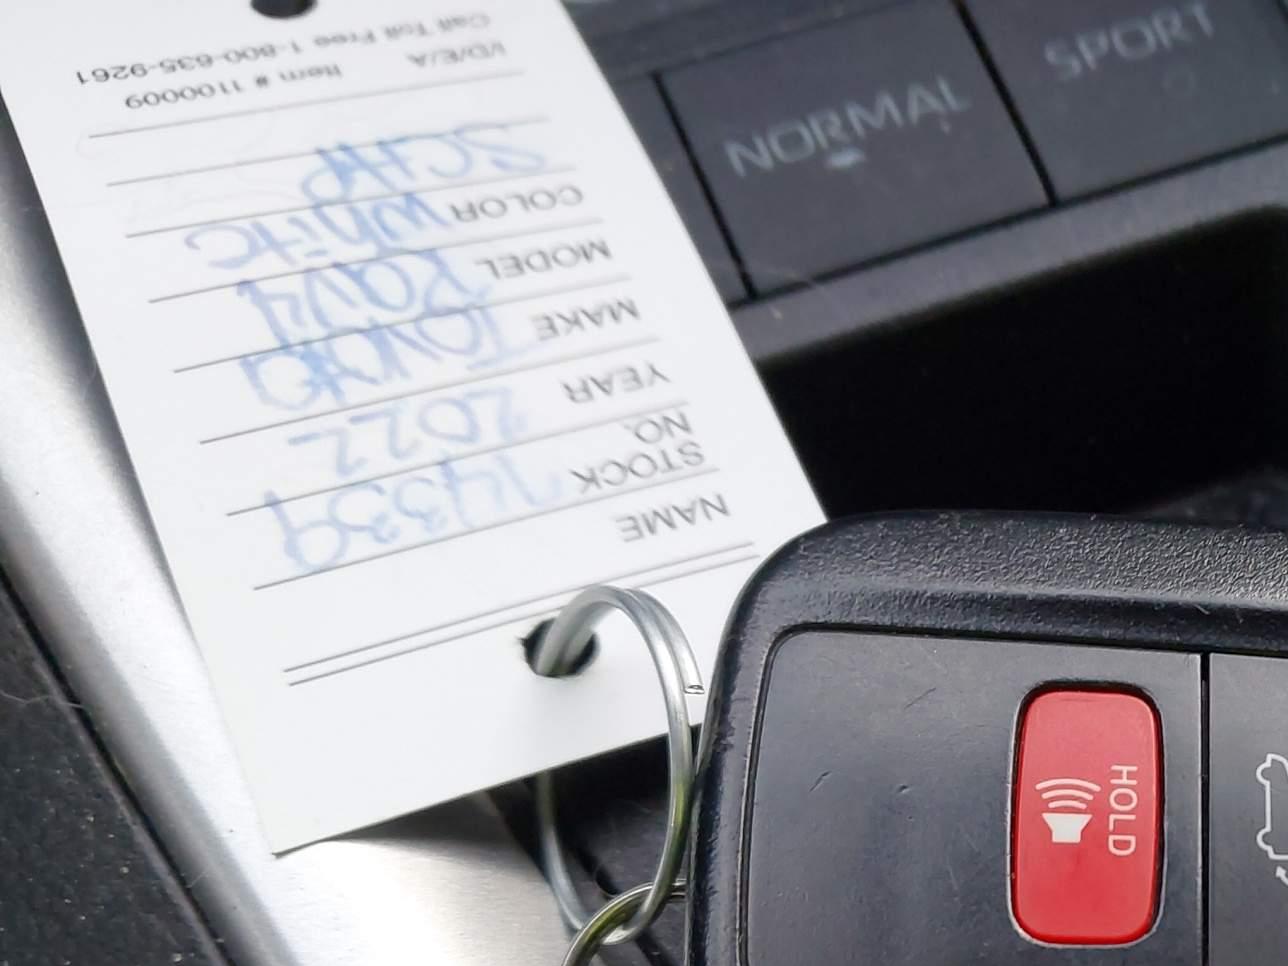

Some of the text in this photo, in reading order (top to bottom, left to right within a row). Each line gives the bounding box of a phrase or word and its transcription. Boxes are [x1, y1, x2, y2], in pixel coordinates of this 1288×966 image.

[312, 30, 377, 46] Free
[1043, 3, 1218, 82] SPORT
[76, 39, 301, 84] 1-800-635-9261
[254, 74, 270, 88] #
[278, 63, 343, 81] Item
[124, 79, 244, 109] 1100009
[723, 74, 975, 179] NORMAL
[450, 185, 585, 225] COLOR
[475, 237, 613, 281] MODEL
[530, 298, 641, 342] MAKE
[559, 359, 672, 406] YEAR
[288, 386, 530, 478] 2022
[632, 410, 693, 444] NO.
[570, 440, 706, 492] STOCK
[618, 493, 731, 544] NAME
[1107, 764, 1137, 857] HOLD
